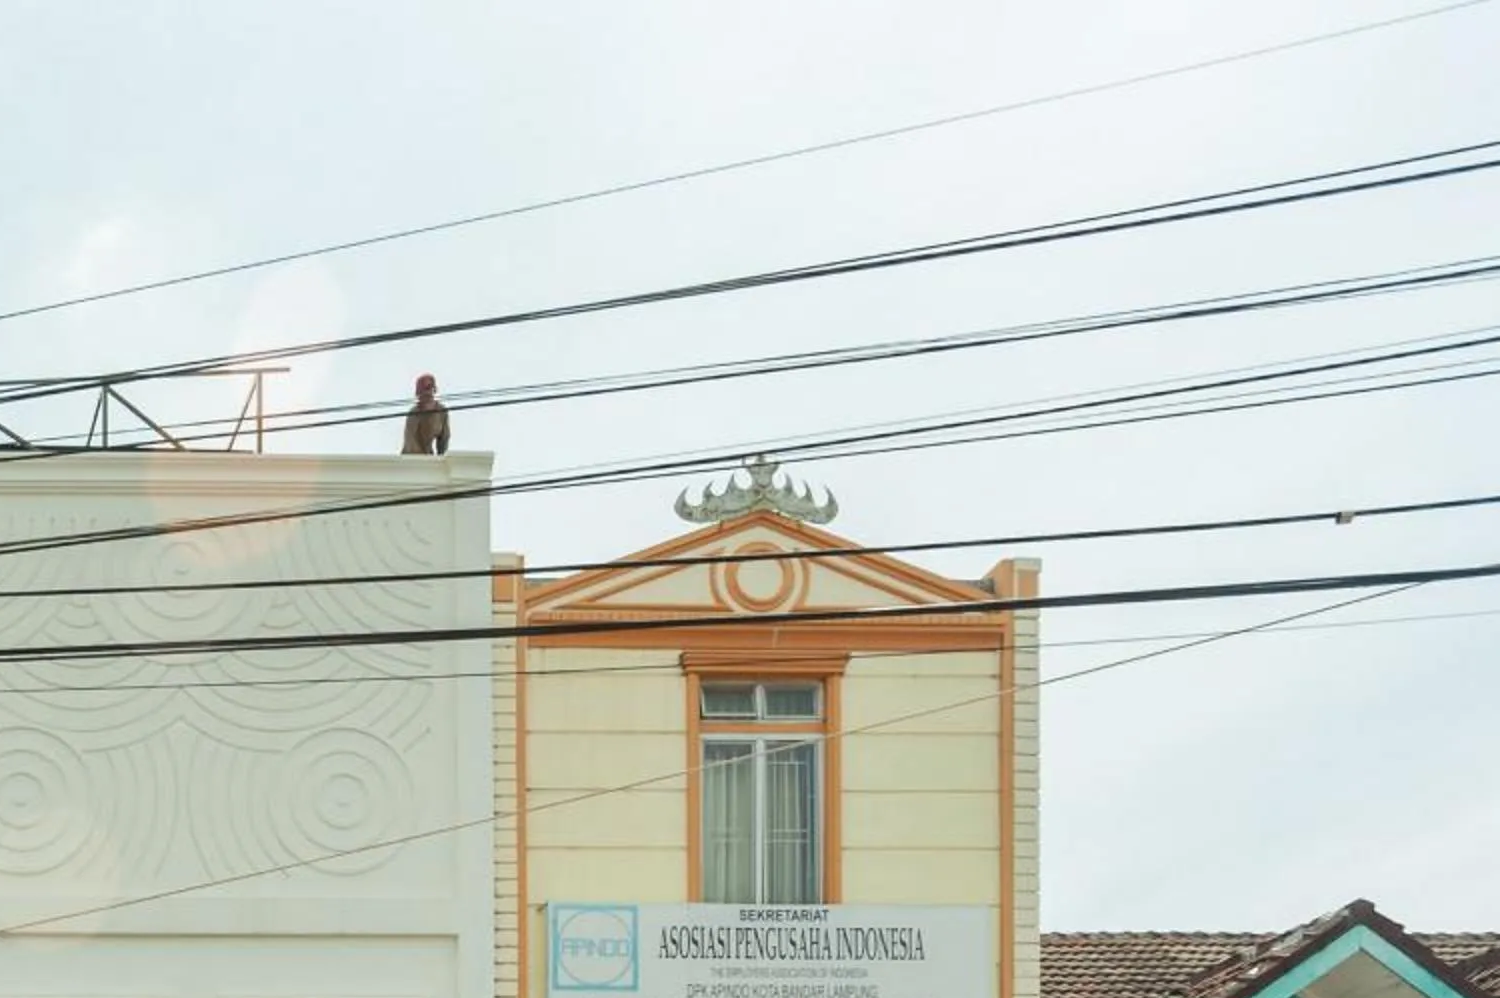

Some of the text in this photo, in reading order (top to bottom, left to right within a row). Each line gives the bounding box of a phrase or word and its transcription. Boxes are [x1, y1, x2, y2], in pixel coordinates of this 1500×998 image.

[739, 909, 829, 922] SEKRETARIAT
[659, 926, 925, 960] ASOSIASI PENGUSAHA INDONESIA
